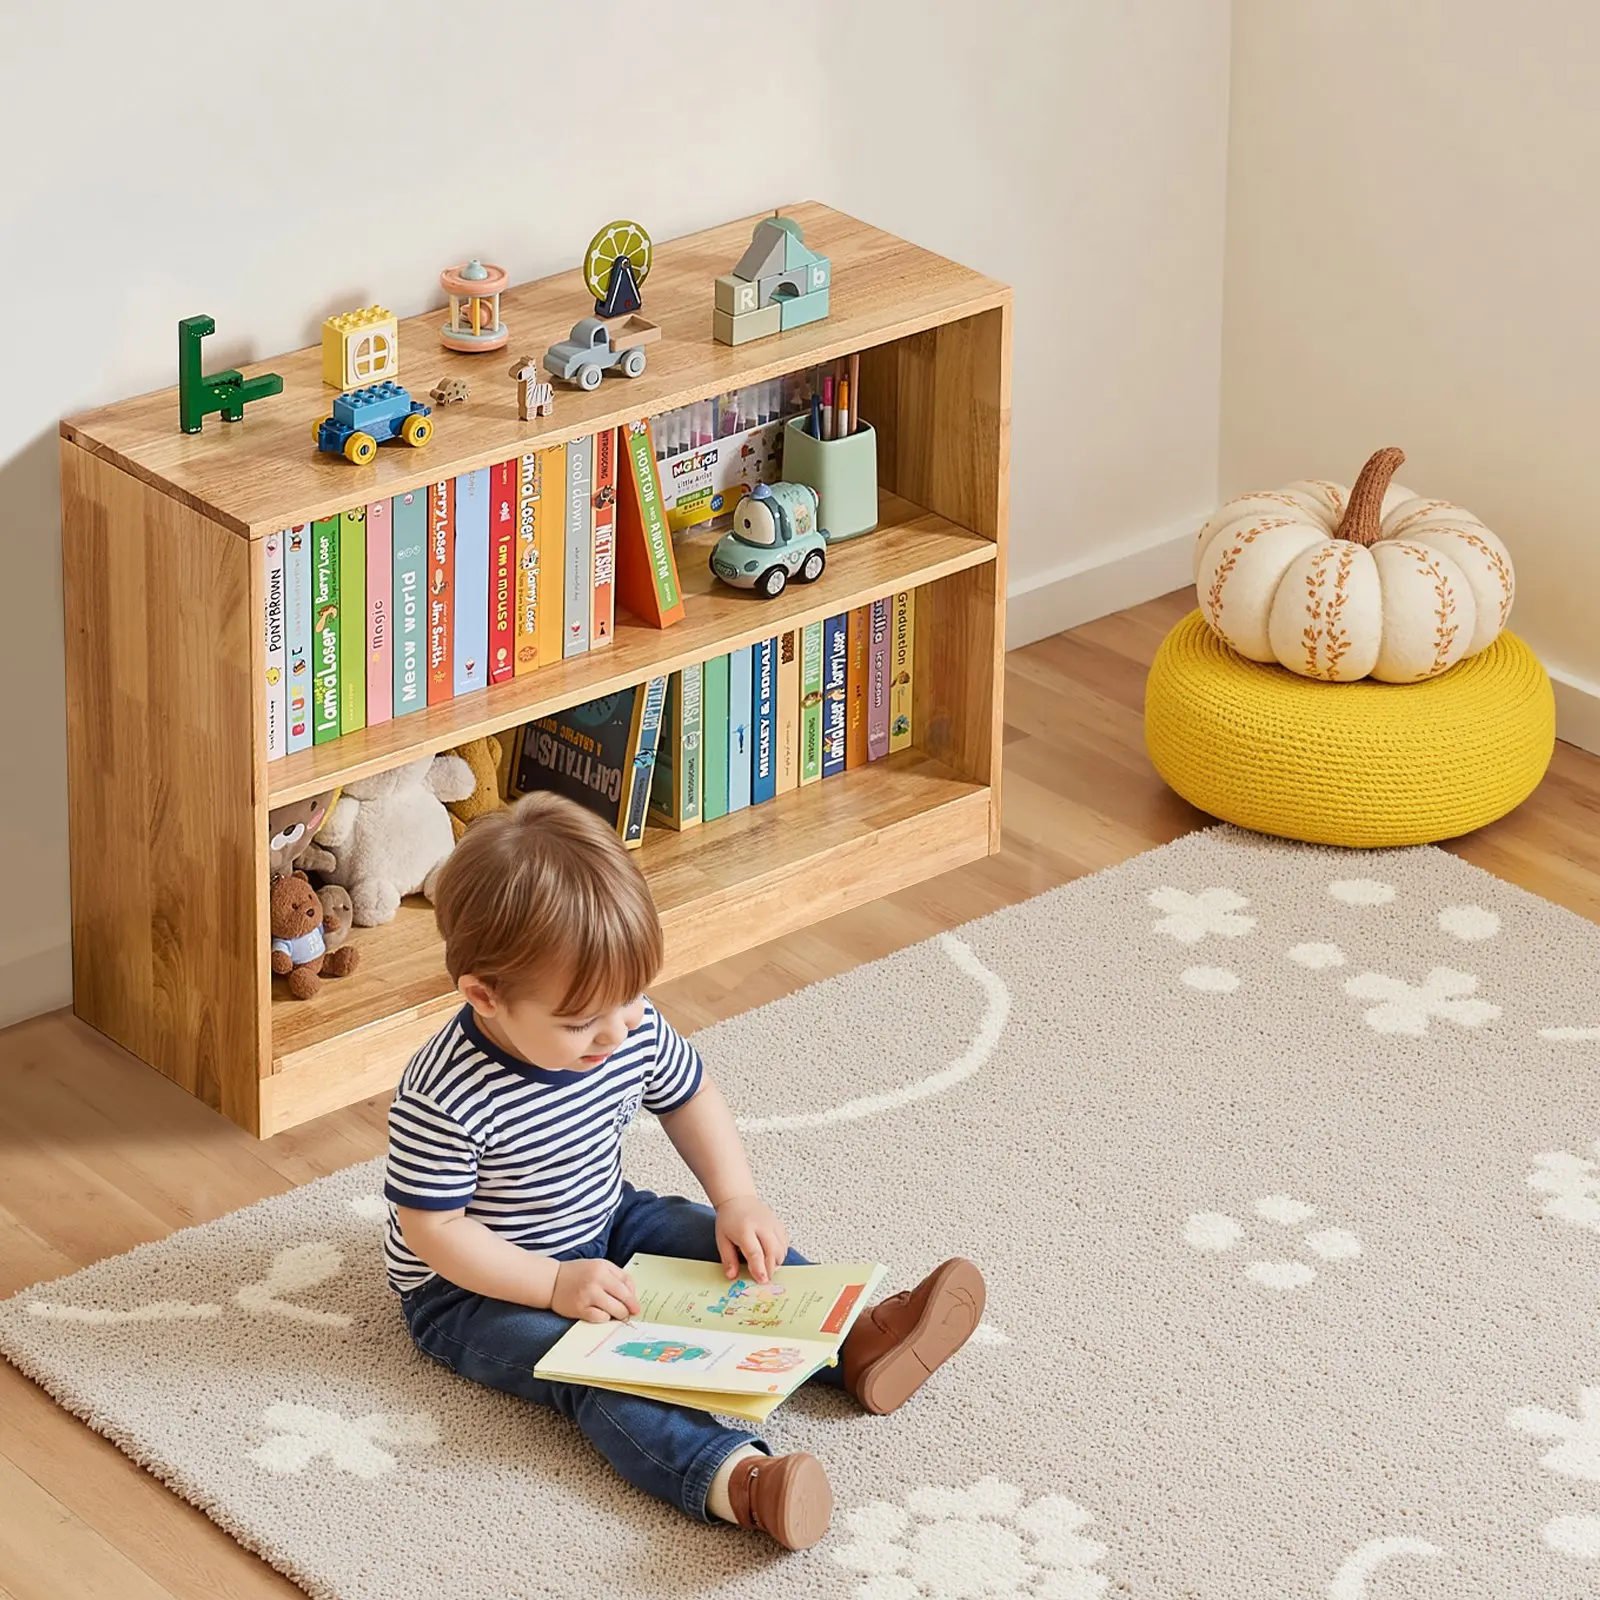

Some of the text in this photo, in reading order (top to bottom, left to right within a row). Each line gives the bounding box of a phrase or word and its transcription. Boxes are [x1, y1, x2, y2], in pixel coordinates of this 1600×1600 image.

[741, 287, 755, 310] R
[813, 267, 826, 288] b
[521, 495, 541, 543] Loser
[572, 453, 591, 533] cool down
[636, 447, 655, 503] HORTON
[650, 521, 670, 580] ANONYM
[435, 480, 448, 564] arry Loser
[315, 536, 330, 604] Barry Loser
[498, 545, 507, 565] am
[498, 568, 507, 577] a
[595, 524, 612, 588] NIETZSCHE
[269, 568, 281, 653] PONYBROWN
[497, 580, 508, 631] mouse
[525, 602, 537, 635] Loser
[897, 591, 908, 666] Graduation
[317, 627, 337, 677] Loser
[402, 571, 416, 702] Meow world
[431, 601, 443, 668] Jim Smith
[805, 621, 820, 685] PHILOSOPH
[826, 631, 846, 690] Barry Loser
[874, 600, 887, 708] anilla ice cream
[323, 688, 337, 719] am
[642, 675, 666, 731] CAPITALIS
[683, 664, 700, 725] PSYCHOLOG
[761, 701, 770, 716] &
[824, 701, 845, 734] Loser
[317, 720, 337, 731] I
[560, 725, 595, 753] GRAPHIC
[596, 742, 603, 757] A
[760, 719, 770, 778] MICKEY
[523, 727, 622, 803] CAPITALISM
[824, 757, 844, 767] I
